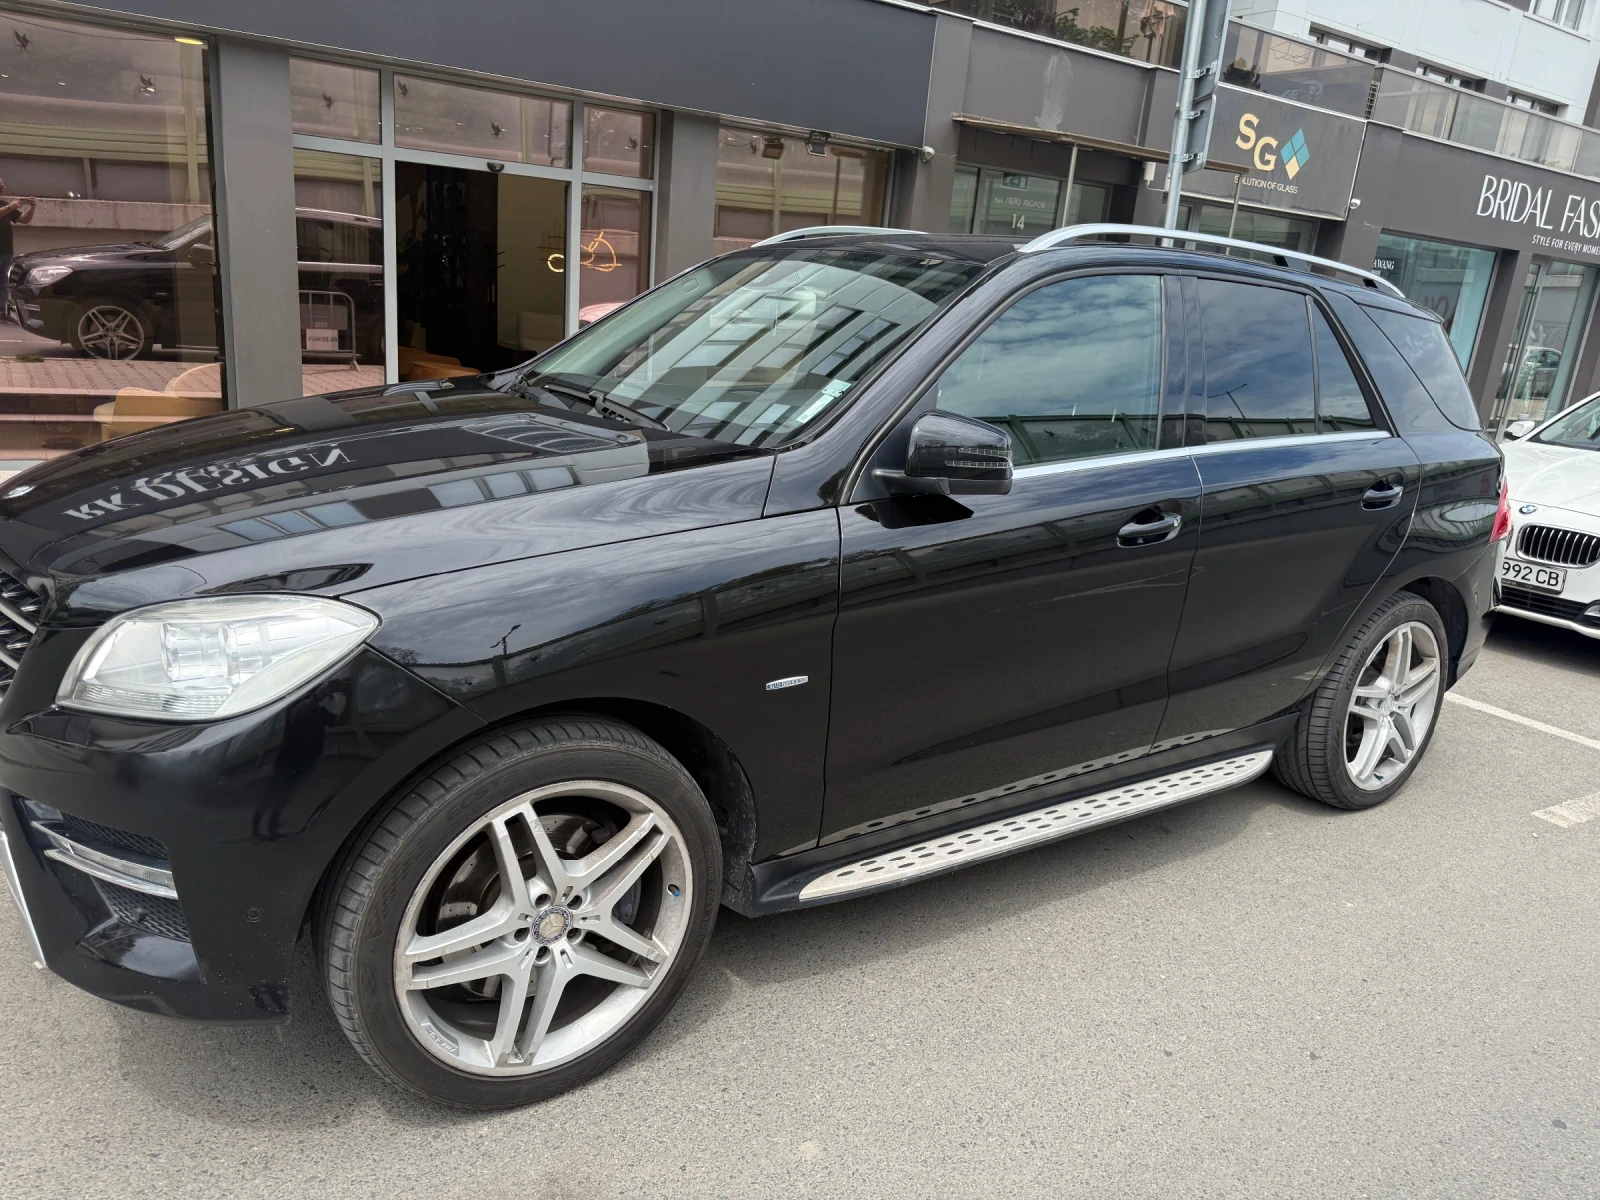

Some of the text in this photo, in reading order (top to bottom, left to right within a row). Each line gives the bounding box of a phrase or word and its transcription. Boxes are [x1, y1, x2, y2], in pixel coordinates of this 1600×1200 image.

[1235, 112, 1278, 172] SG
[1267, 181, 1277, 190] OF
[1277, 183, 1298, 194] GLASS
[1476, 174, 1600, 239] BRIDAL FAS
[1012, 213, 1025, 230] 14
[1532, 234, 1600, 256] STYLE FOR EVERY MOME
[1502, 561, 1560, 587] 992 CB
[1345, 647, 1369, 690] KUMHO
